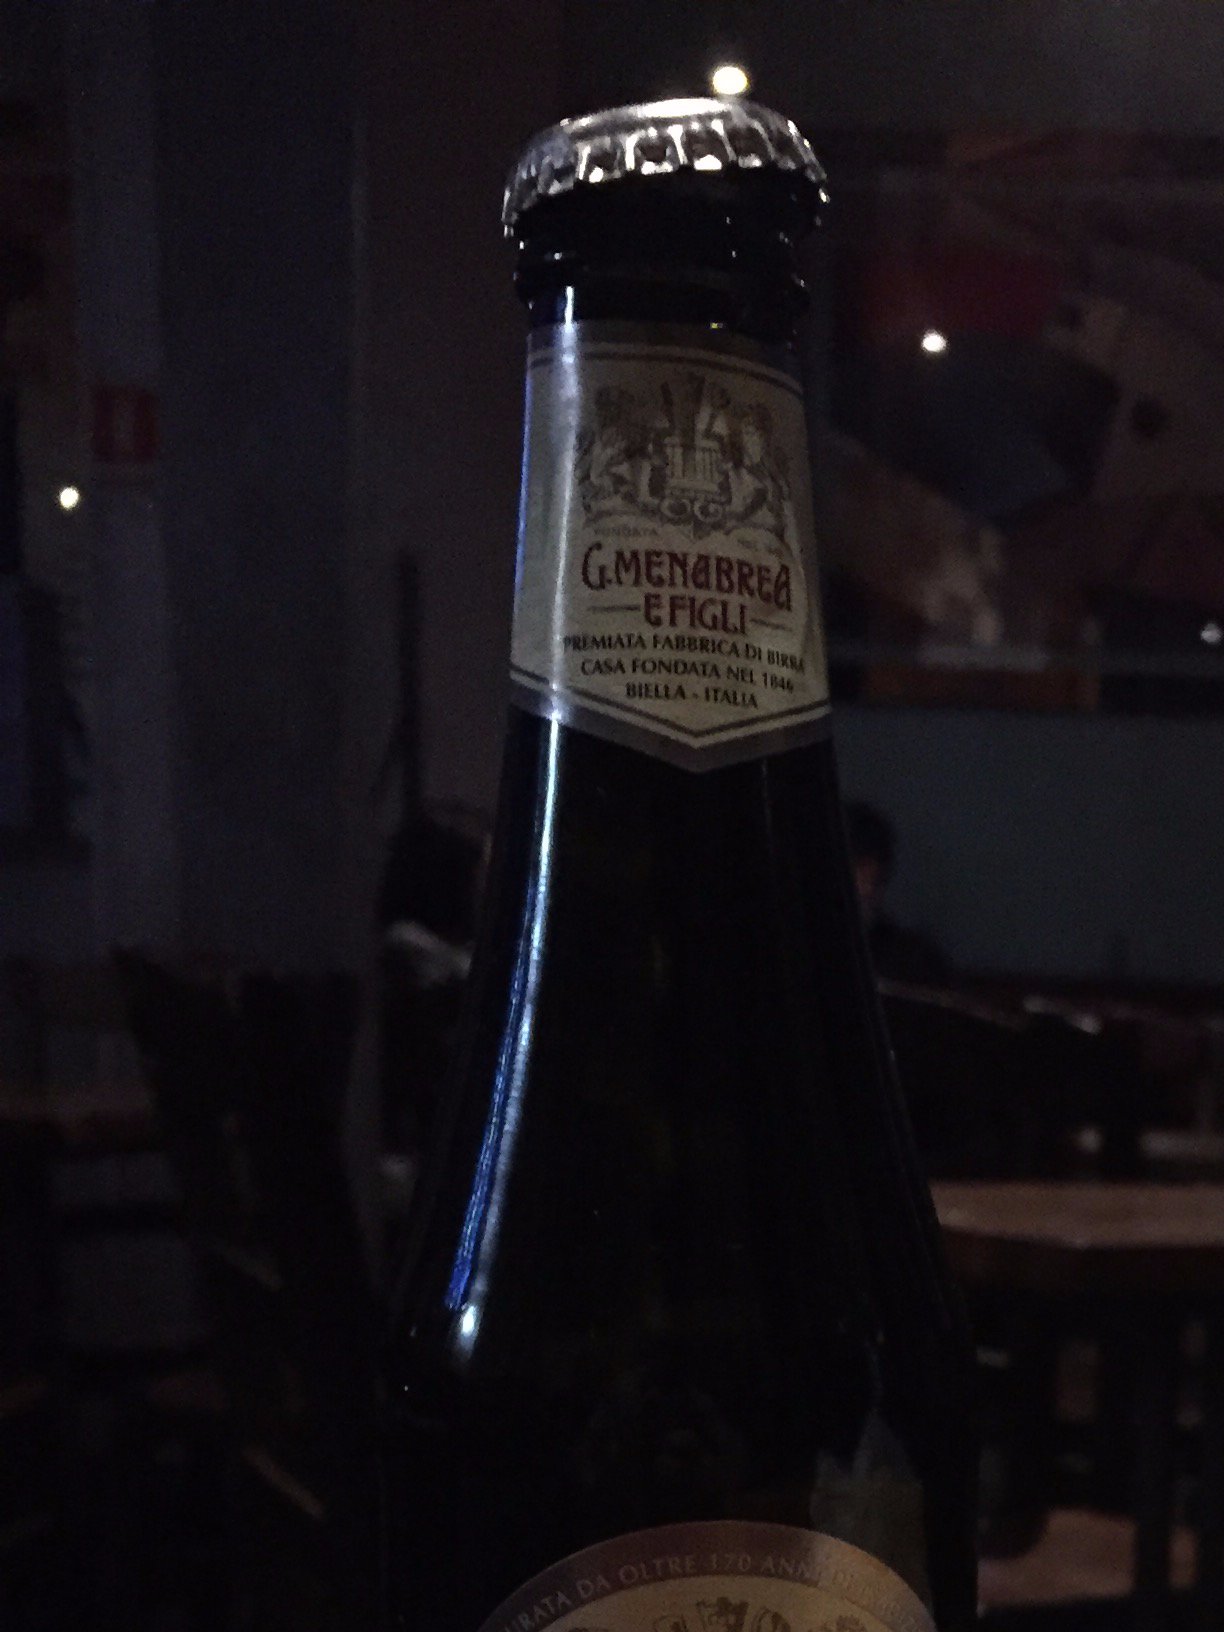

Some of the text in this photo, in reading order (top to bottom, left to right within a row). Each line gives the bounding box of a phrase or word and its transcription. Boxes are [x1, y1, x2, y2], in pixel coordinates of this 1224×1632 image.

[581, 542, 792, 611] G.MENABREA
[563, 634, 805, 673] PREMIATA FABBRICA DI BIRRA
[580, 658, 794, 693] CASA FONDATA NEL 1846
[625, 682, 686, 700] BIELLA
[704, 686, 758, 709] ITALIA
[576, 1578, 612, 1599] DA
[619, 1554, 697, 1585] OLTRE
